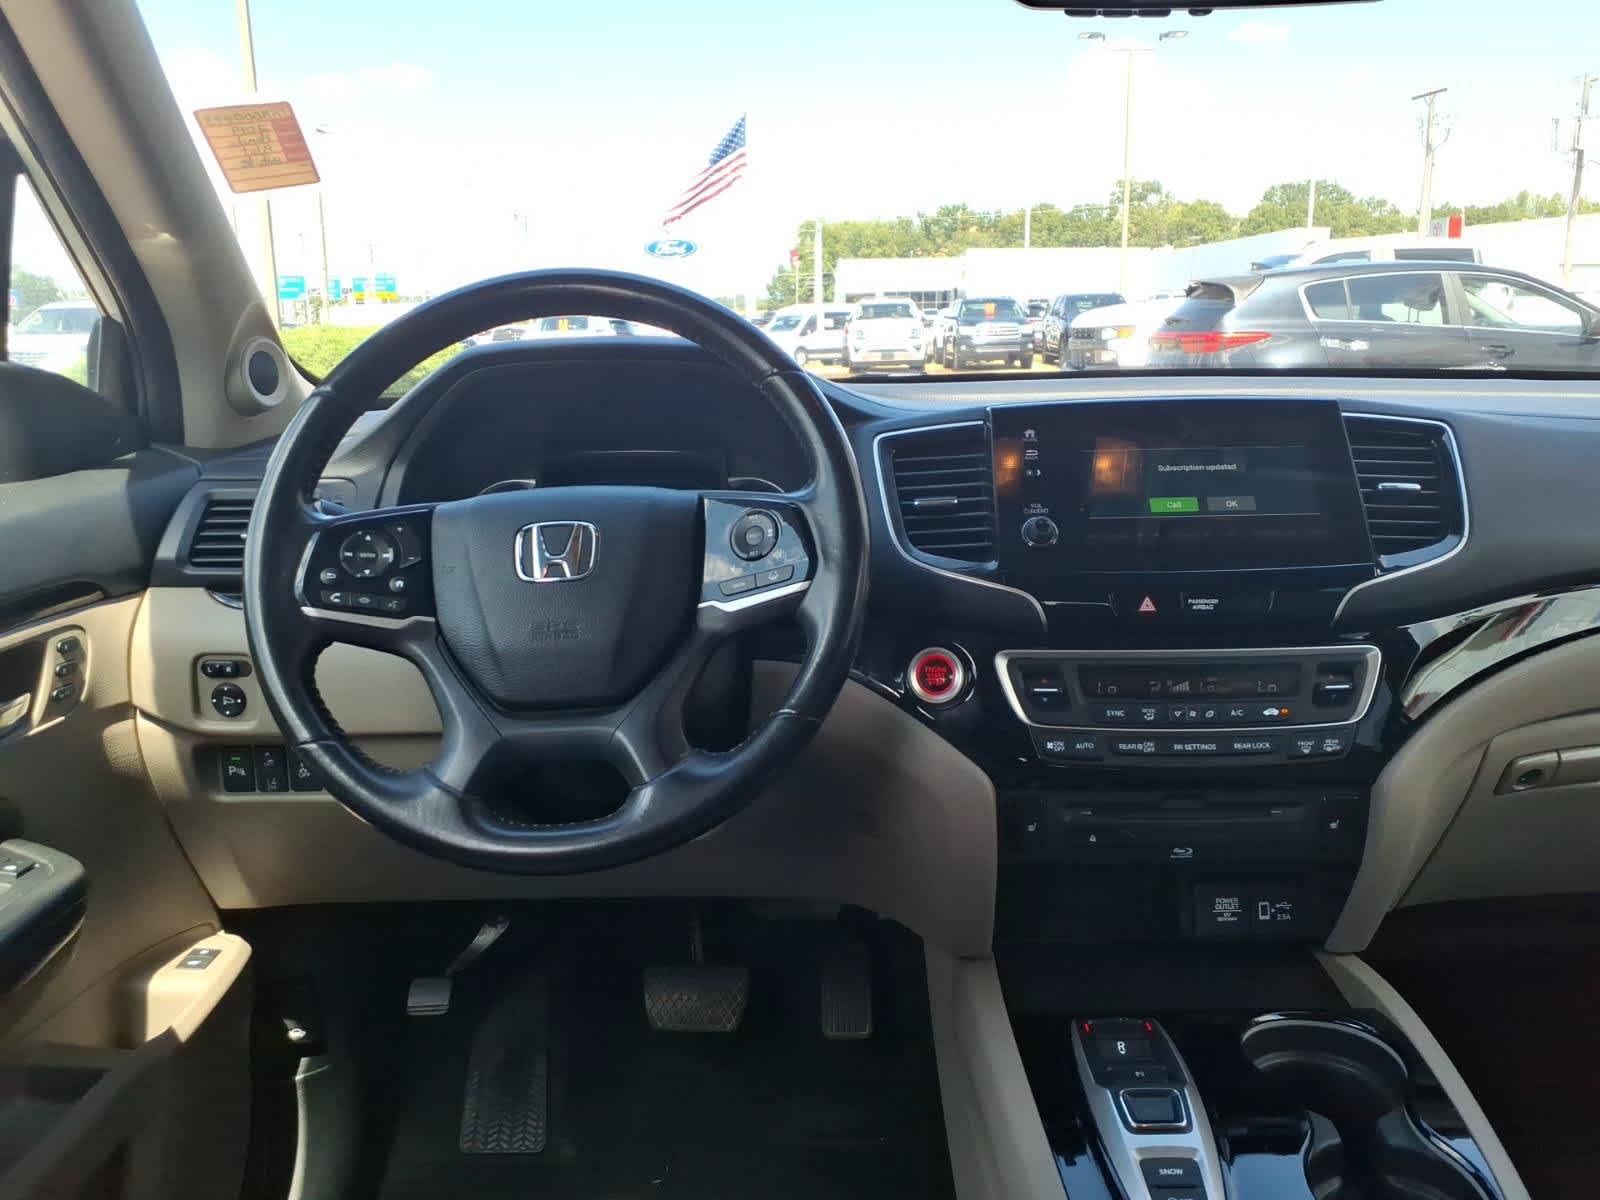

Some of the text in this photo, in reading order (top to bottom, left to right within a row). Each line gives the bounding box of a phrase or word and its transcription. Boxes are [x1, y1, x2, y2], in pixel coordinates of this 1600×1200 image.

[1157, 464, 1237, 472] Subscription updated
[1166, 500, 1182, 509] Call
[1225, 500, 1239, 508] OK
[1106, 709, 1126, 717] SYNC
